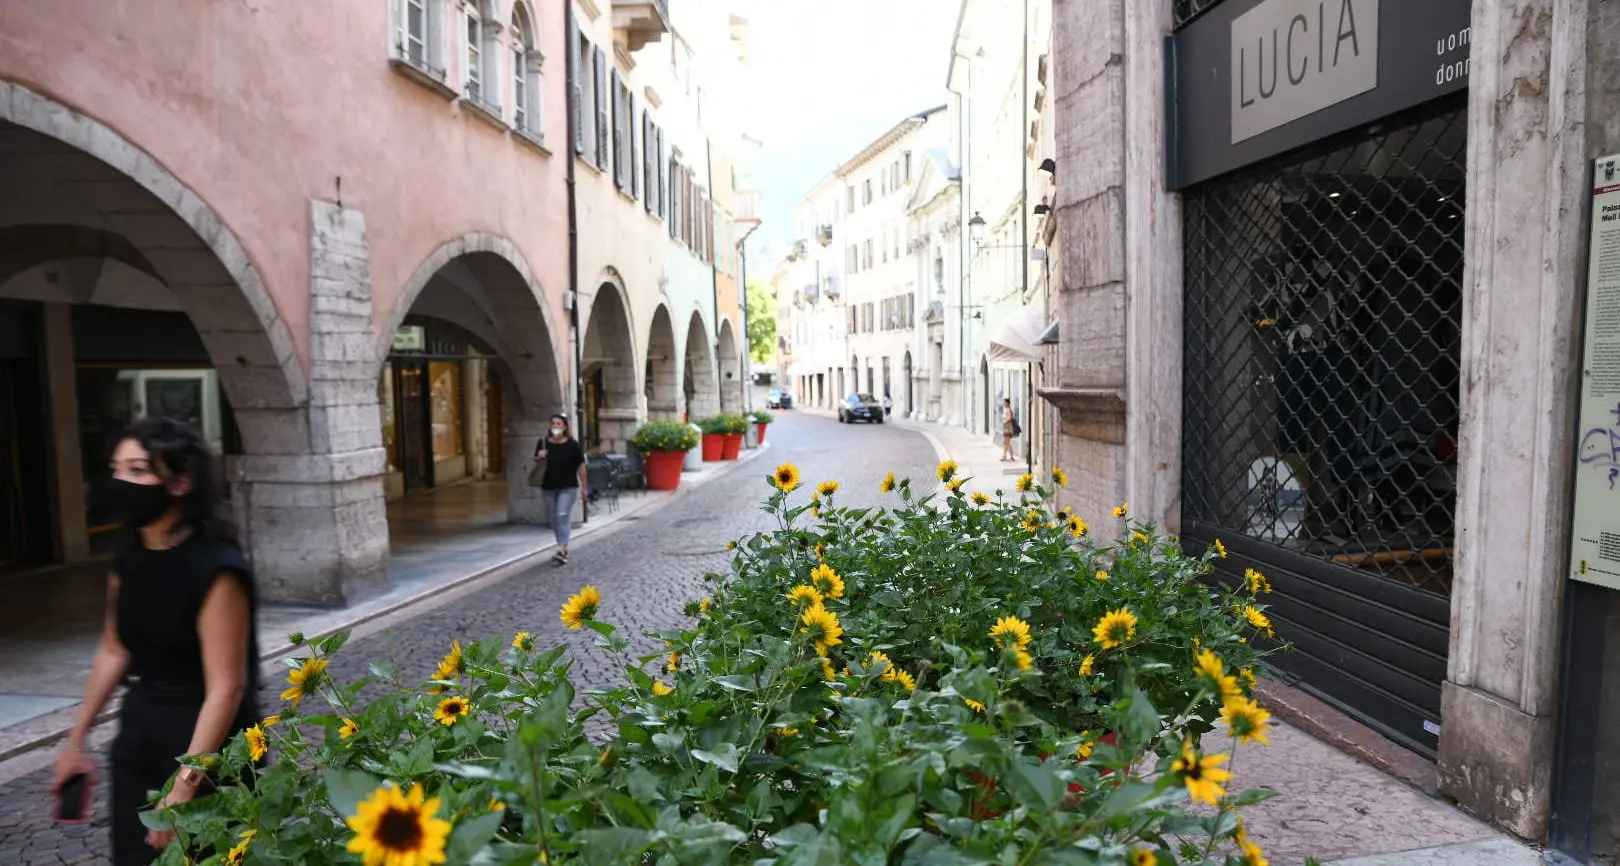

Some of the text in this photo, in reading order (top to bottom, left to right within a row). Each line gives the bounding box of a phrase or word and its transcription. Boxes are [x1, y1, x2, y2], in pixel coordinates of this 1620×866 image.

[1240, 0, 1360, 109] LUCIA
[1437, 26, 1471, 56] uom
[1436, 62, 1471, 85] donn
